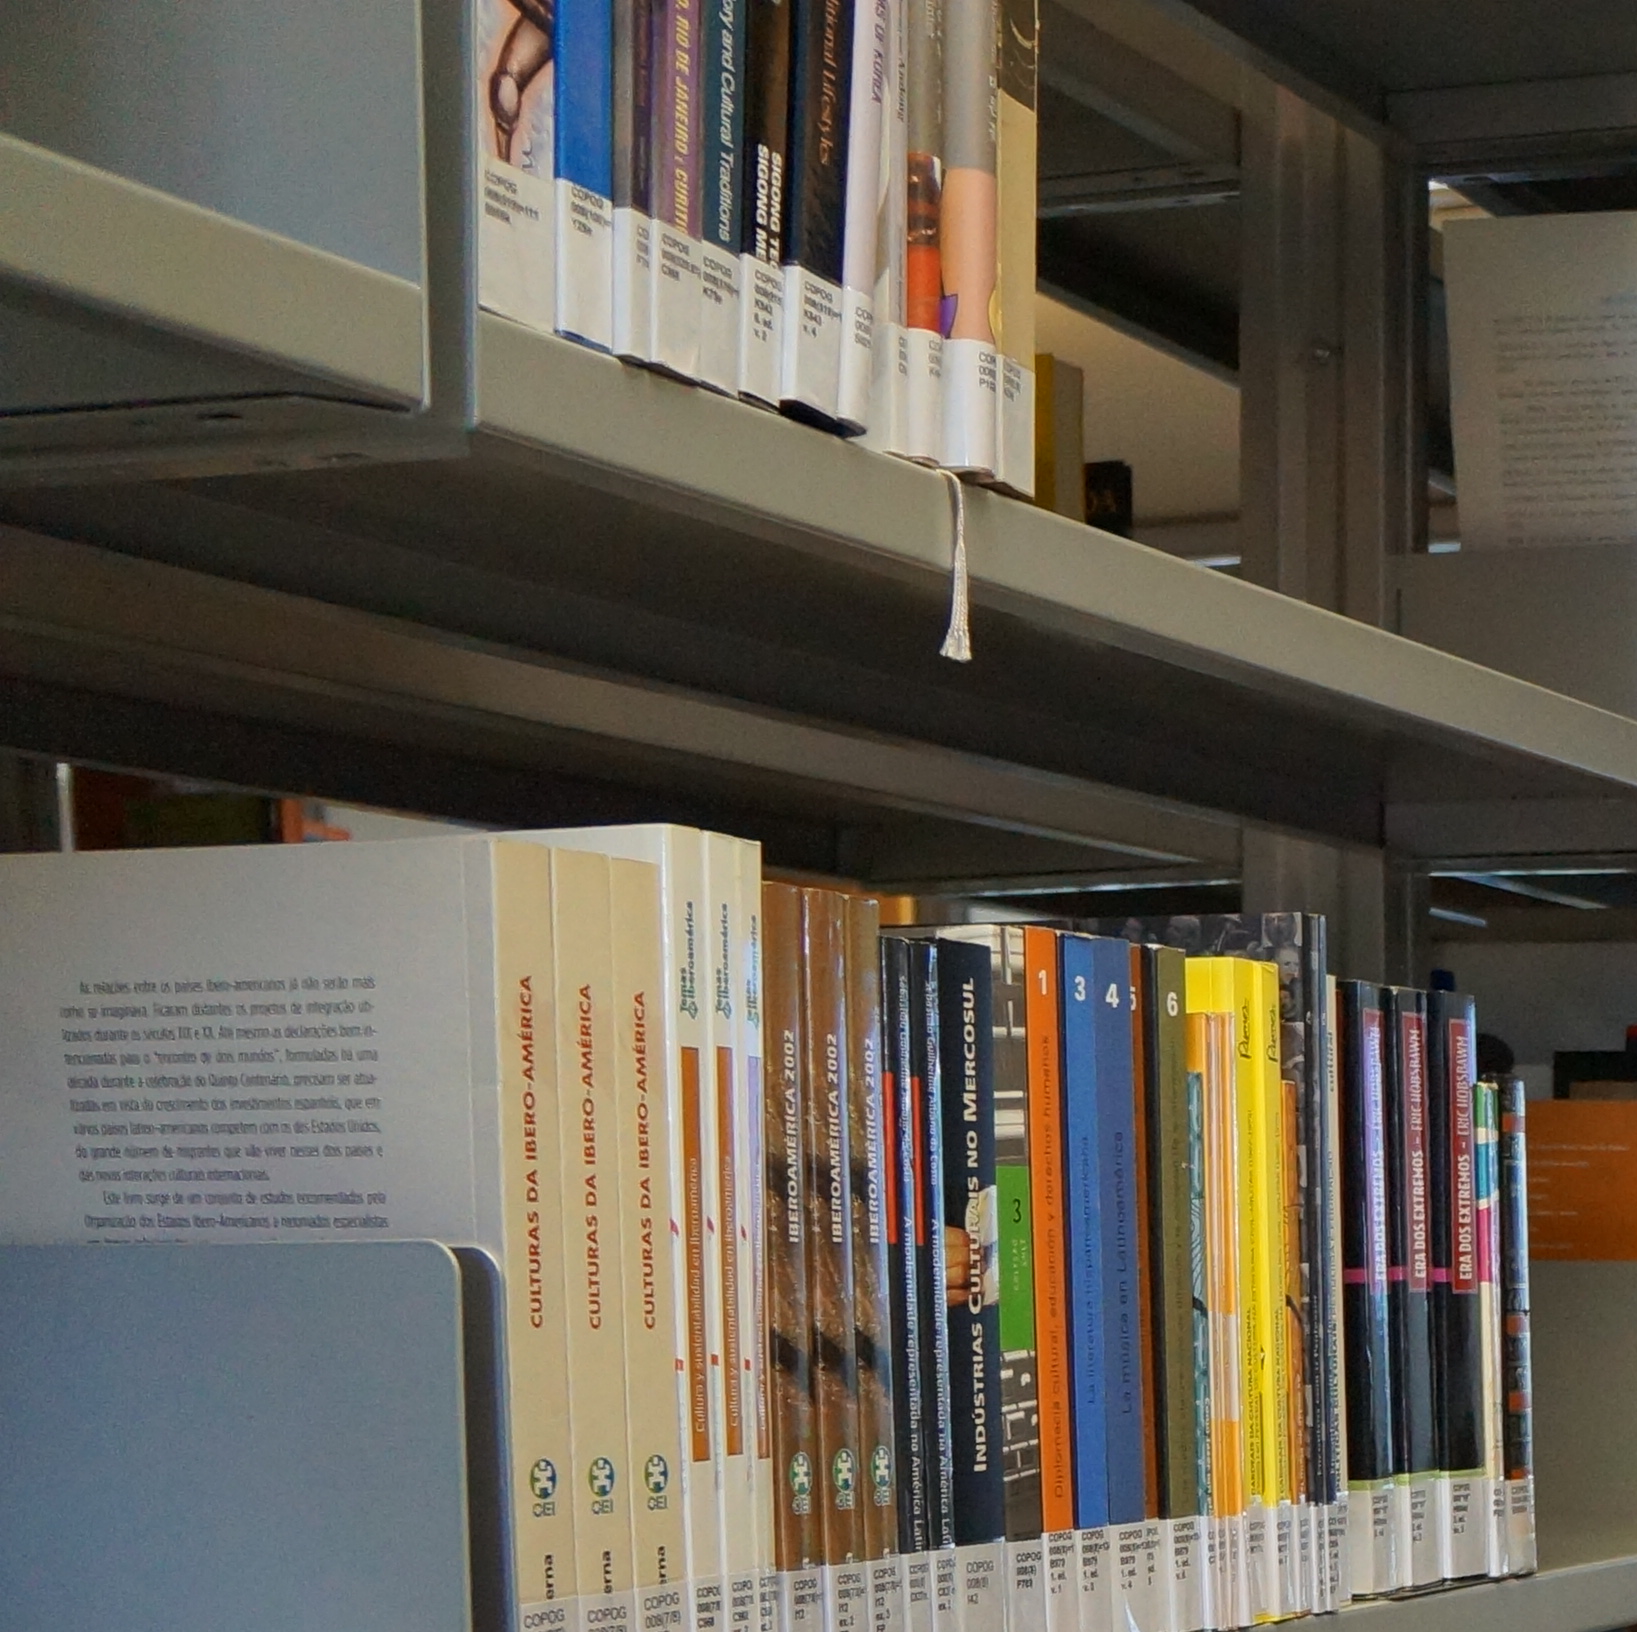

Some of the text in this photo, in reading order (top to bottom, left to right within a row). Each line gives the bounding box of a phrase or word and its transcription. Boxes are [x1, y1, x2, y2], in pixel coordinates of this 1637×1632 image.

[716, 29, 737, 244] and Cultural Traditions
[817, 68, 837, 167] Lifestyles
[755, 143, 770, 221] SIGONG
[769, 152, 785, 232] SIGONG
[1037, 971, 1048, 996] 1
[1073, 975, 1087, 1002] 3
[1105, 982, 1120, 1009] 4
[1166, 990, 1179, 1017] 6
[1040, 1035, 1053, 1119] humanos
[517, 975, 544, 1330] CULTURAS DA IBERO-AMÉRICA
[576, 983, 602, 1331] CULTURAS DA IBERO-AMÉRICA
[632, 991, 656, 1331] CULTURAS DA IBERO-AMÉRICA
[782, 1028, 800, 1243] IBEROAMÉRICA 2002
[826, 1032, 843, 1244] IBEROAMÉRICA 2002
[864, 1037, 880, 1244] IBEROAMÉRICA 2002
[962, 977, 988, 1473] INDÚSTRIAS CULTURAIS NO MERCOSUL
[1411, 1150, 1426, 1221] EXTREMOS
[1456, 1153, 1471, 1224] EXTREMOS
[1412, 1222, 1426, 1250] DOS
[1413, 1252, 1427, 1279] ERA
[1457, 1225, 1471, 1252] DOS
[1458, 1254, 1472, 1280] ERA
[903, 1231, 925, 1515] modernidade representada América
[1050, 1401, 1065, 1500] Diplomacia
[588, 1606, 628, 1624] COPOG
[644, 1591, 681, 1612] COPOG
